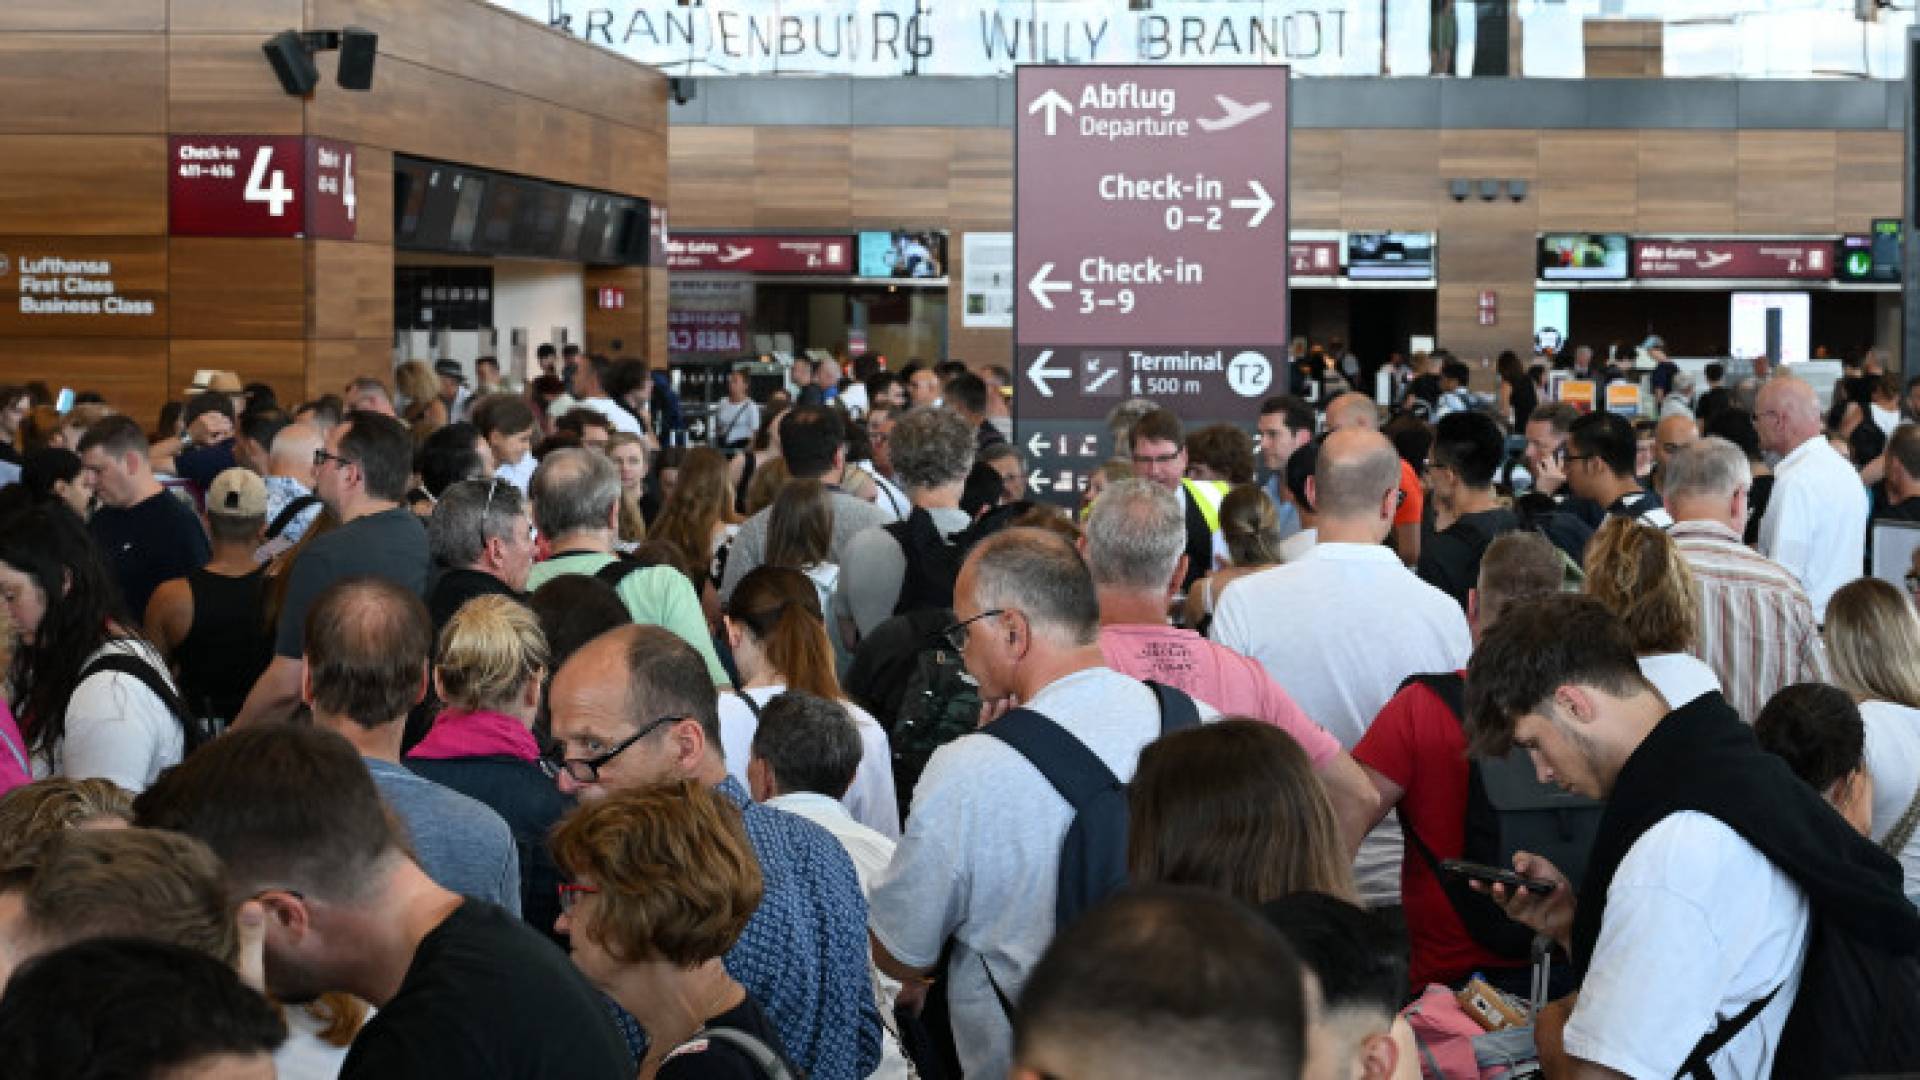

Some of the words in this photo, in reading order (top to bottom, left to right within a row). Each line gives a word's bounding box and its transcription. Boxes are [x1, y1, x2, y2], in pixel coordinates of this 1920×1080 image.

[550, 8, 932, 62] RANENBURG
[980, 9, 1108, 64] WILLY
[1139, 10, 1350, 60] BRANDT
[1079, 82, 1176, 116] Abflug
[1079, 115, 1190, 141] Departure
[179, 145, 240, 160] Check-in
[243, 145, 294, 217] 4
[1098, 173, 1223, 200] Check-in
[18, 256, 111, 275] Lufthansa
[1079, 256, 1203, 284] Check-in
[19, 275, 61, 294] First
[63, 276, 114, 294] Class
[19, 296, 101, 314] Business
[104, 296, 155, 314] Class
[1128, 350, 1224, 372] Terminal
[1233, 363, 1265, 386] T2
[1147, 377, 1180, 394] 500
[1185, 379, 1201, 394] m
